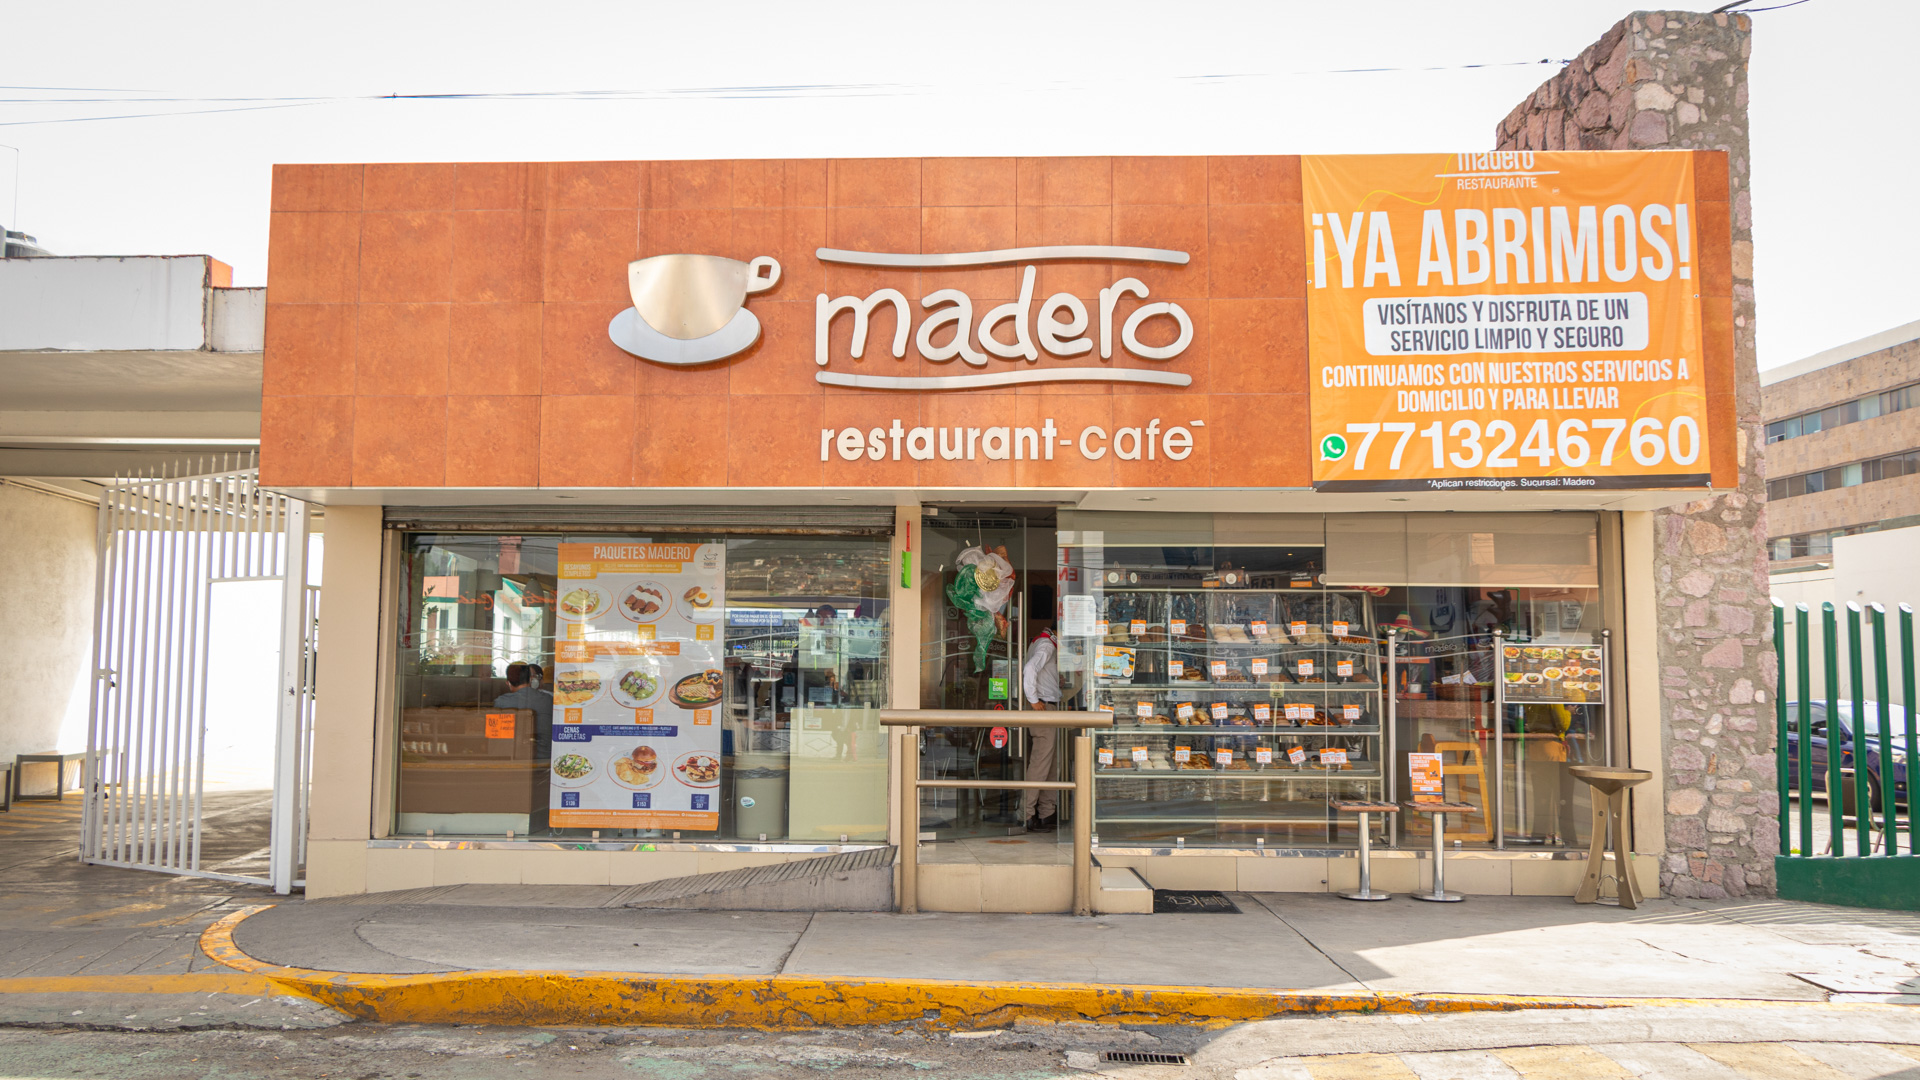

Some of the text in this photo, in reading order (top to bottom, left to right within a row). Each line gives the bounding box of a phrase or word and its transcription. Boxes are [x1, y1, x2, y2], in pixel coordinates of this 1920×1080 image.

[1457, 177, 1538, 190] RESTAURANTE
[1312, 203, 1691, 288] ¡YA ABRIMOS!
[816, 265, 1194, 366] madero
[1377, 298, 1629, 325] VISÍTANOS Y DISFRUTA DE UN
[1390, 325, 1623, 352] SERVICIO LIMPIO Y SEGURO
[1322, 358, 1689, 388] CONTINUAMOS CON NUESTROS SERVICIOS A
[1397, 387, 1619, 412] DOMICILIO Y PARA LLEVAR
[1346, 416, 1700, 470] 7713246760
[1520, 478, 1561, 487] Sucursal:
[1563, 478, 1595, 486] Madero
[593, 546, 691, 560] PAQUETES MADERO
